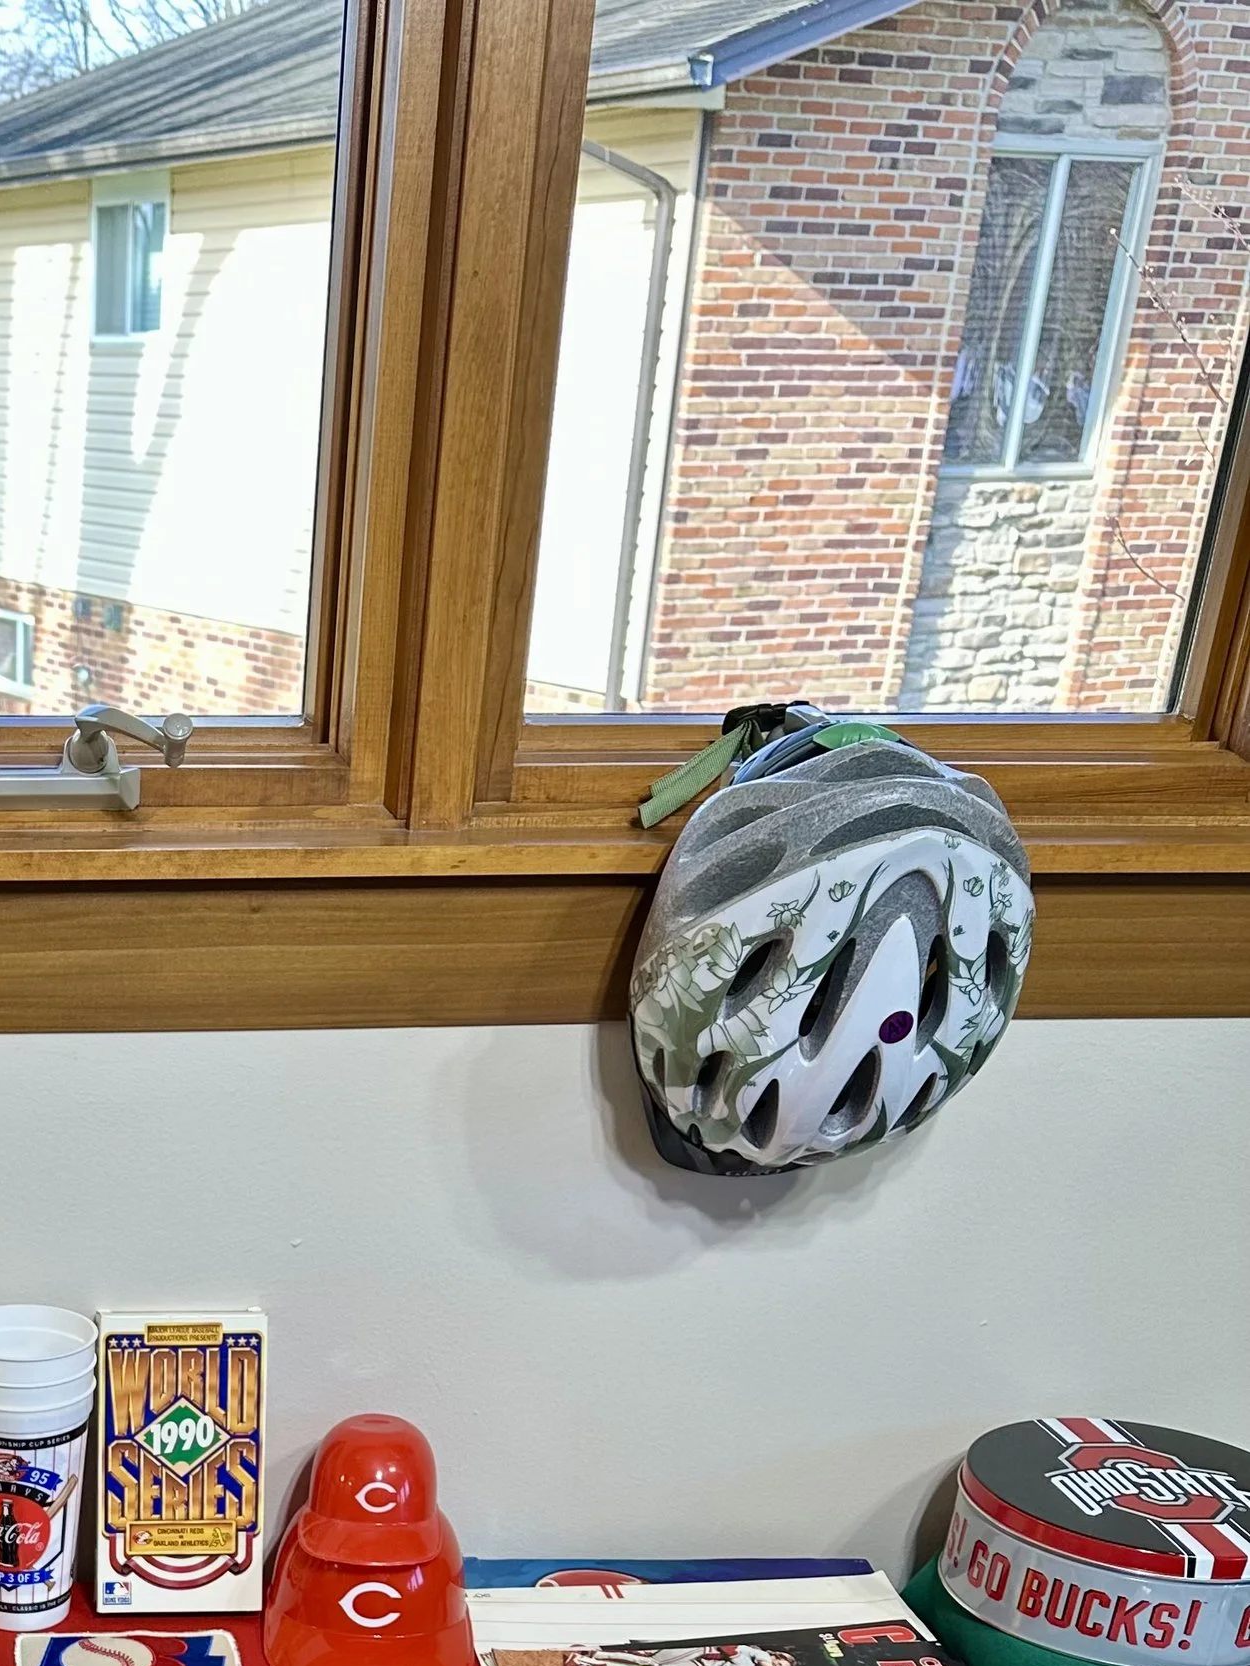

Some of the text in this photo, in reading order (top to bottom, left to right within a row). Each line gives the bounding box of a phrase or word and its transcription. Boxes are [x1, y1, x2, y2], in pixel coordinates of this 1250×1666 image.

[108, 1348, 259, 1436] WORLD
[47, 1434, 70, 1446] SERIES
[150, 1415, 215, 1456] 1990
[29, 1470, 50, 1485] 95
[108, 1439, 258, 1530] SERIES
[354, 1481, 397, 1513] C
[8, 1574, 15, 1583] 3
[17, 1574, 31, 1583] OF
[33, 1572, 40, 1582] 5
[967, 1540, 1012, 1602] GO
[1017, 1567, 1202, 1650] BUCKS!
[338, 1581, 402, 1628] C
